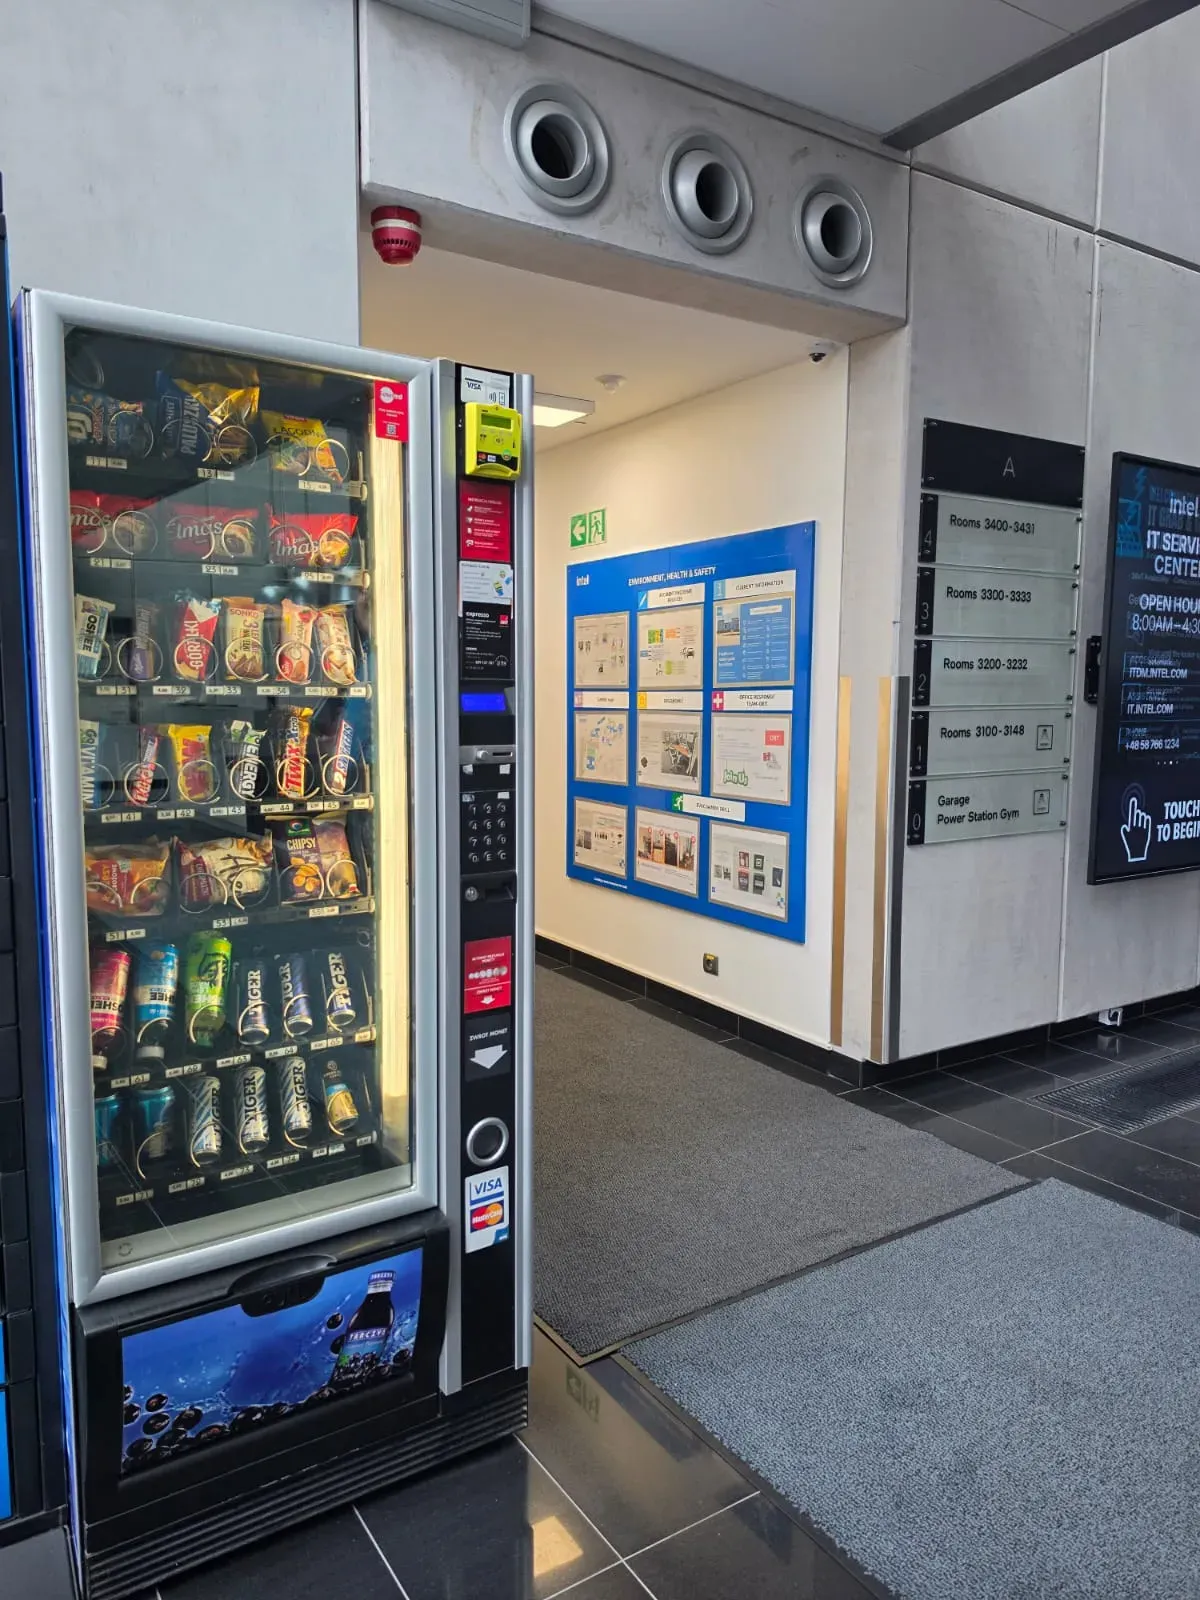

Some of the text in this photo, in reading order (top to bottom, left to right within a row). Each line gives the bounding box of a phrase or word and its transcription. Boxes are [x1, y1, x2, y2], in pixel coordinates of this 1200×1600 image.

[467, 382, 482, 391] VISA
[181, 397, 200, 455] PALUSZKI
[1003, 456, 1015, 478] A
[949, 514, 1035, 537] Rooms 3400-3431
[925, 529, 933, 547] 4
[1147, 529, 1200, 556] IT SERVI
[695, 566, 717, 578] SAFETY
[946, 586, 1032, 604] Rooms 3300-3333
[1140, 593, 1170, 612] OPEN
[921, 602, 929, 620] 3
[943, 657, 1029, 671] Rooms 3200-3232
[918, 673, 927, 691] 2
[940, 724, 1026, 740] Rooms 3100-3148
[80, 746, 97, 804] VITAMIN
[937, 795, 970, 808] Garage
[1163, 799, 1200, 820] TOUCH
[937, 808, 1020, 826] Power Station Gym
[1156, 823, 1171, 842] TO
[286, 837, 316, 851] CHIPSY
[328, 952, 353, 1008] TIGER
[248, 969, 263, 1017] TIGER
[474, 1177, 503, 1195] VISA
